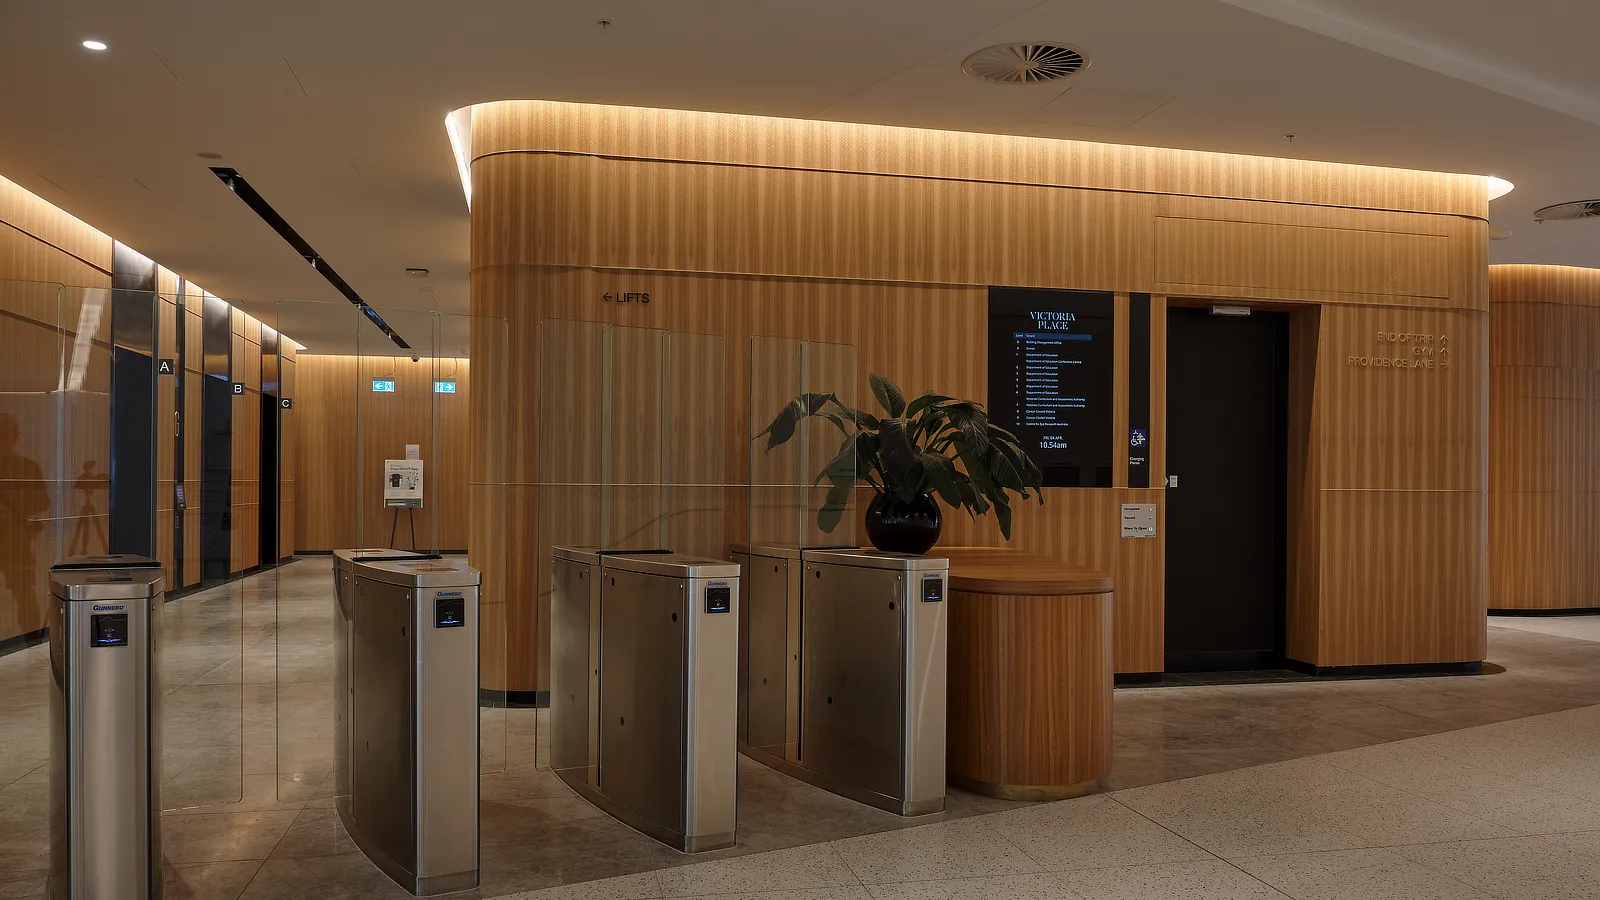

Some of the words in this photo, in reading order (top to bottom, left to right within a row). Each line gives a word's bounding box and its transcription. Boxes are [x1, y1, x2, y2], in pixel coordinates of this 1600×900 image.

[616, 292, 650, 304] LIFTS
[1030, 311, 1076, 321] VICTORIA
[1038, 320, 1069, 330] PLACE
[1377, 331, 1397, 342] END
[1398, 333, 1411, 343] OF
[1414, 334, 1434, 344] TRIP
[1412, 346, 1434, 356] GYM
[160, 361, 170, 372] A
[1348, 356, 1407, 368] PROVIDENCE
[1409, 359, 1434, 369] LANE
[234, 384, 242, 393] B
